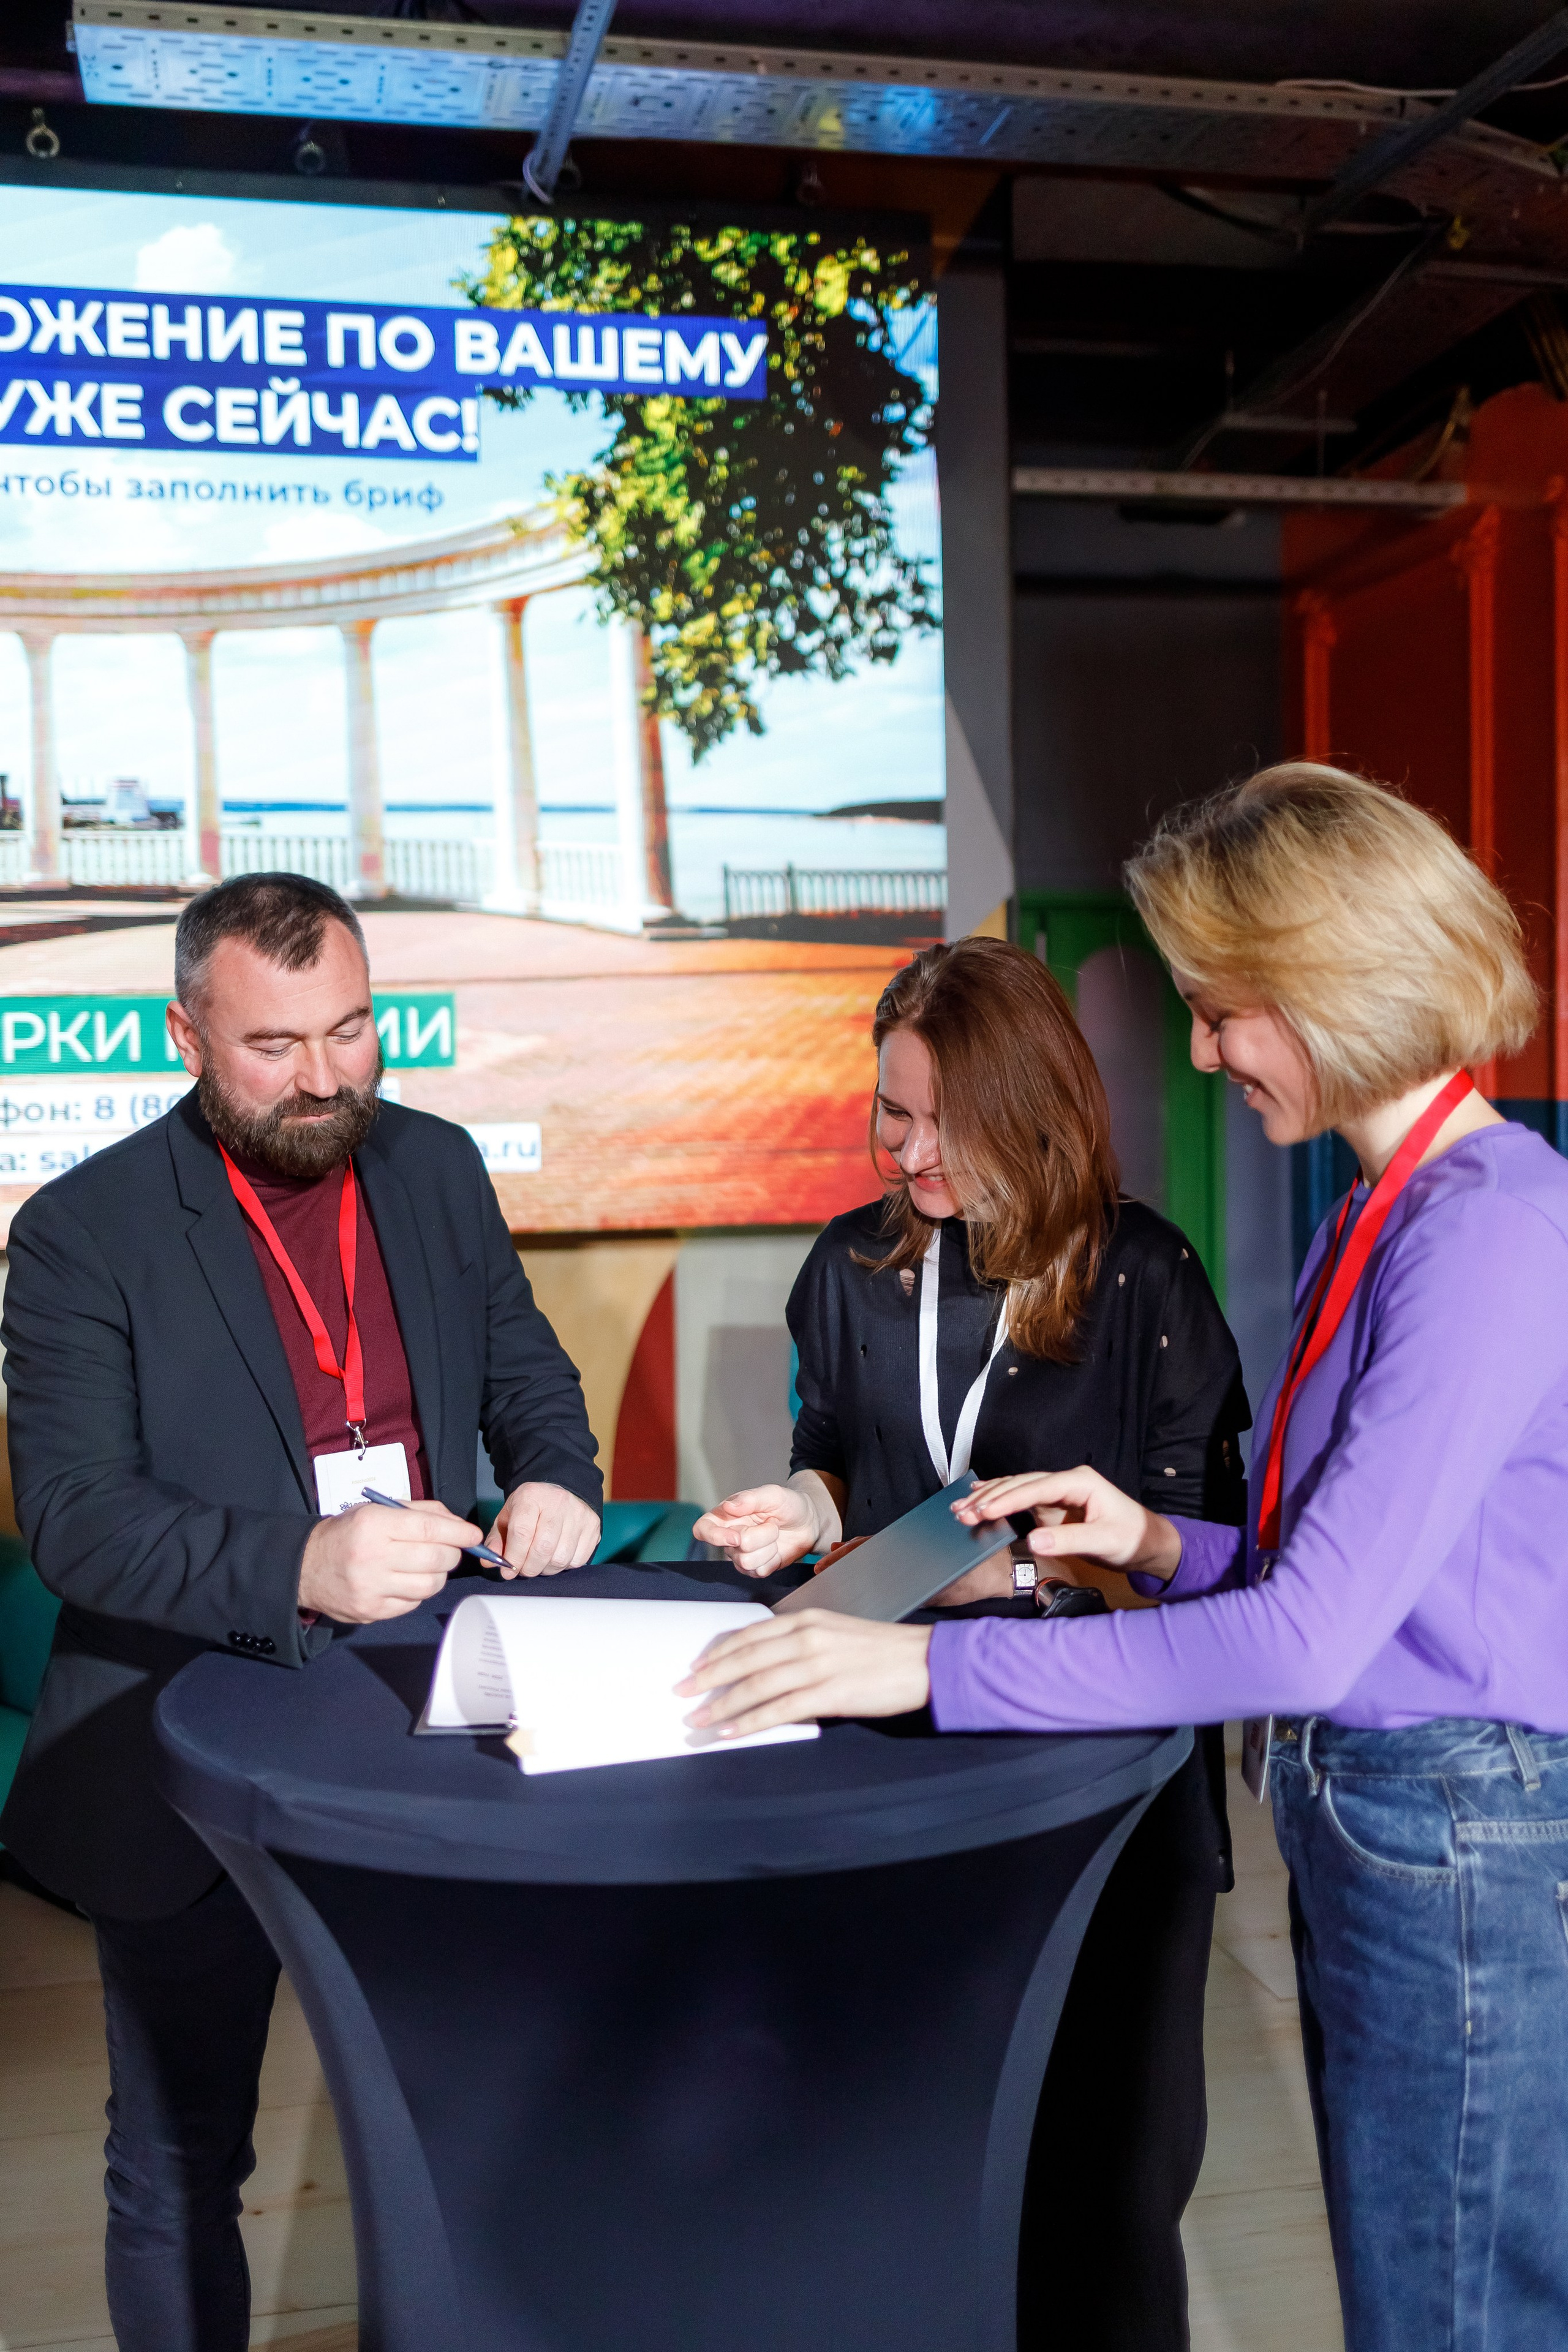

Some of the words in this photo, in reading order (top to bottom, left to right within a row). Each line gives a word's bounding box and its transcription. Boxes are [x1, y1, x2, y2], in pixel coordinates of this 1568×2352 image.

[326, 311, 436, 372] ПО
[454, 317, 769, 389] ВАШЕМУ
[162, 375, 480, 454] СЕЙЧАС!
[125, 477, 333, 507] заполнить
[344, 478, 445, 515] бриф
[2, 1010, 141, 1064] РКИ
[94, 1094, 116, 1120] 8
